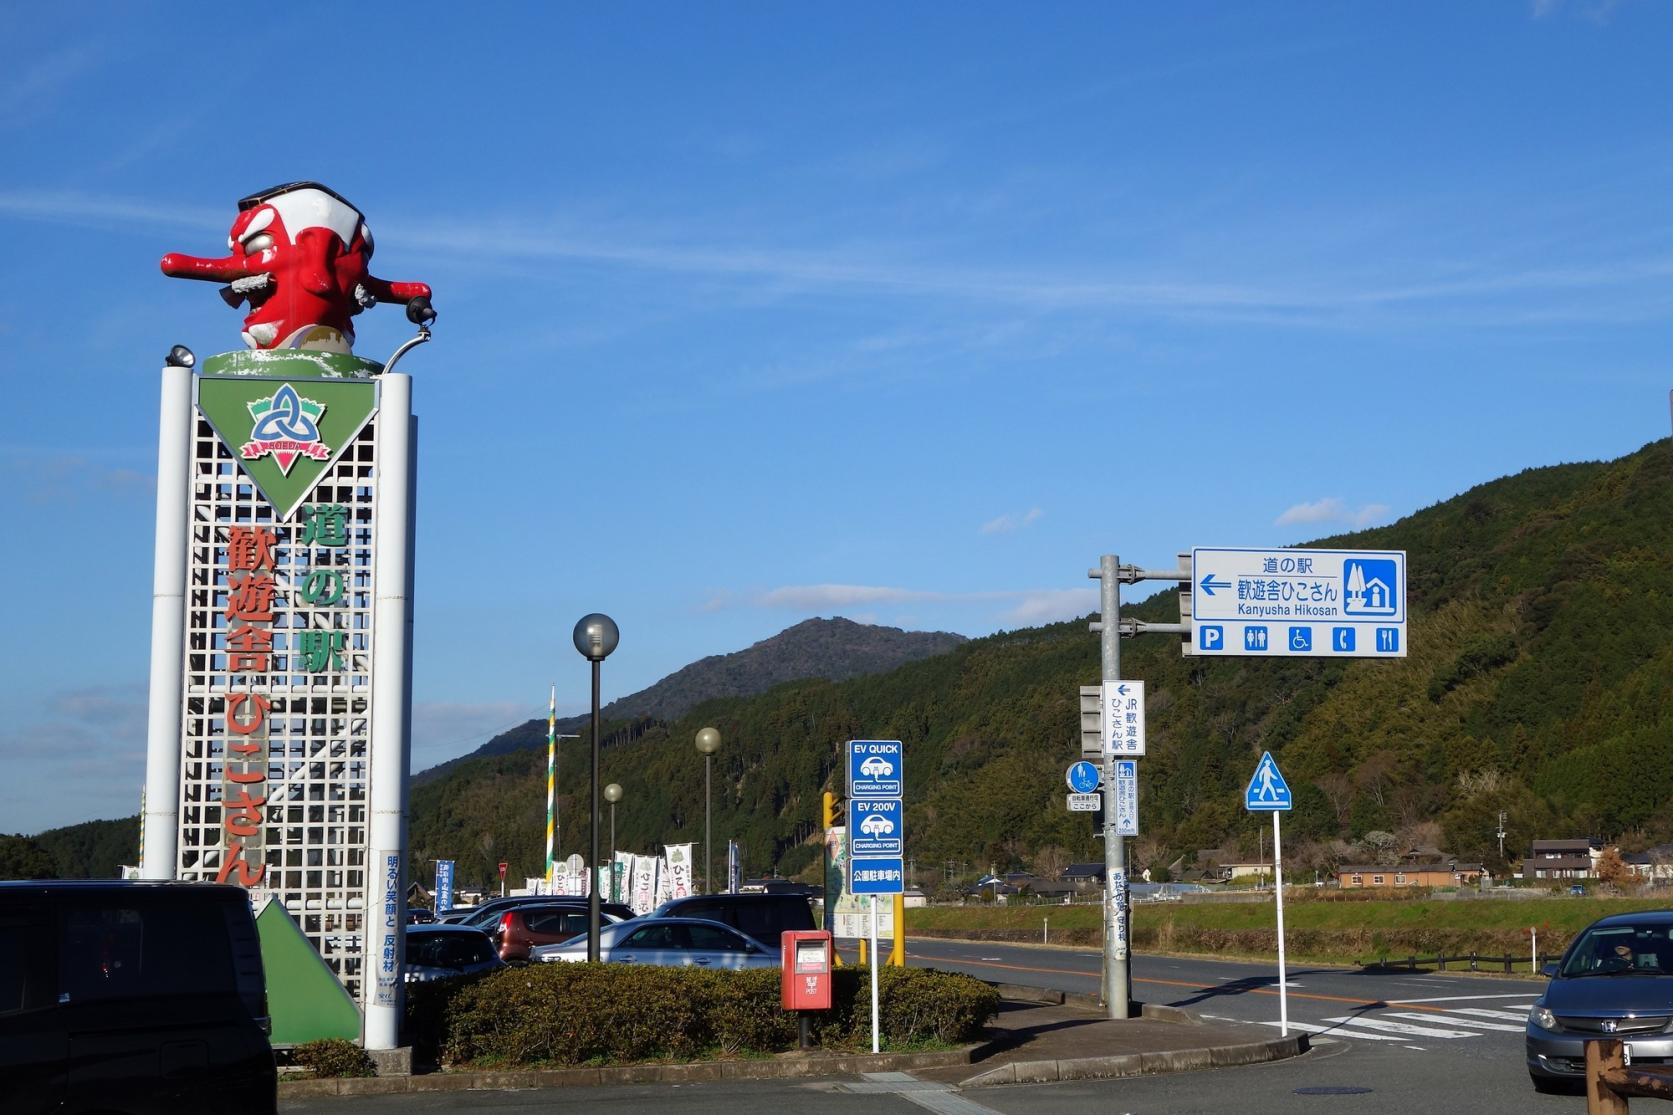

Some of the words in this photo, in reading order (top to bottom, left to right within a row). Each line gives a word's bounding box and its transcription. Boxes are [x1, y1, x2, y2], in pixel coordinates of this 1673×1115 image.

[1263, 557, 1313, 574] 道の駅
[300, 504, 348, 673] 道の駅
[1237, 579, 1338, 602] 歓遊舎ひこさん
[1238, 603, 1290, 617] Kanyusha
[1294, 604, 1338, 616] Hikosan
[1111, 698, 1124, 751] ひこさん駅
[854, 745, 867, 754] EV
[869, 745, 898, 754] QUICK
[857, 803, 870, 811] EV
[872, 803, 896, 811] 200V
[853, 869, 901, 882] 公園駐車場内
[384, 855, 398, 928] 明るい笑顔と
[382, 934, 396, 973] 反射材
